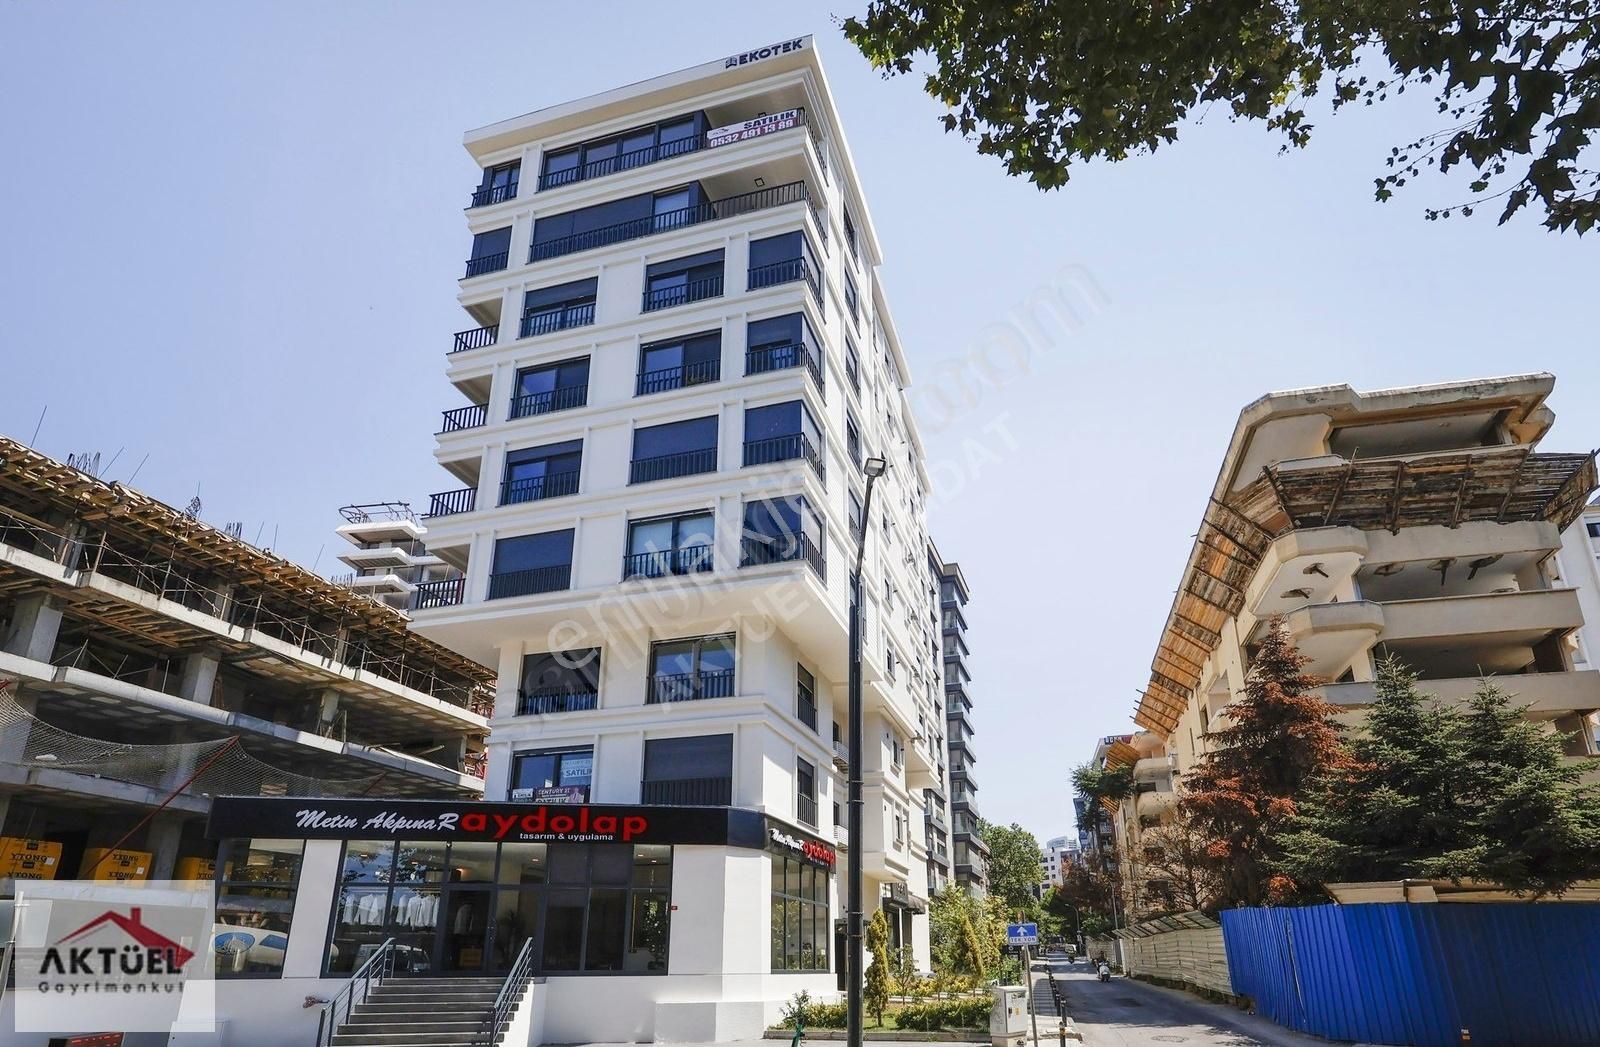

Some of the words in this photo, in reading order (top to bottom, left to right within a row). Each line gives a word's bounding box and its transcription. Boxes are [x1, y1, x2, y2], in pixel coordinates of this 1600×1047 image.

[740, 39, 803, 65] EKOTEK
[711, 133, 738, 148] 0532
[741, 126, 760, 140] 491
[295, 809, 358, 829] Metin
[460, 806, 648, 841] aydolap
[567, 834, 613, 842] uygulama
[11, 853, 47, 863] YTONG
